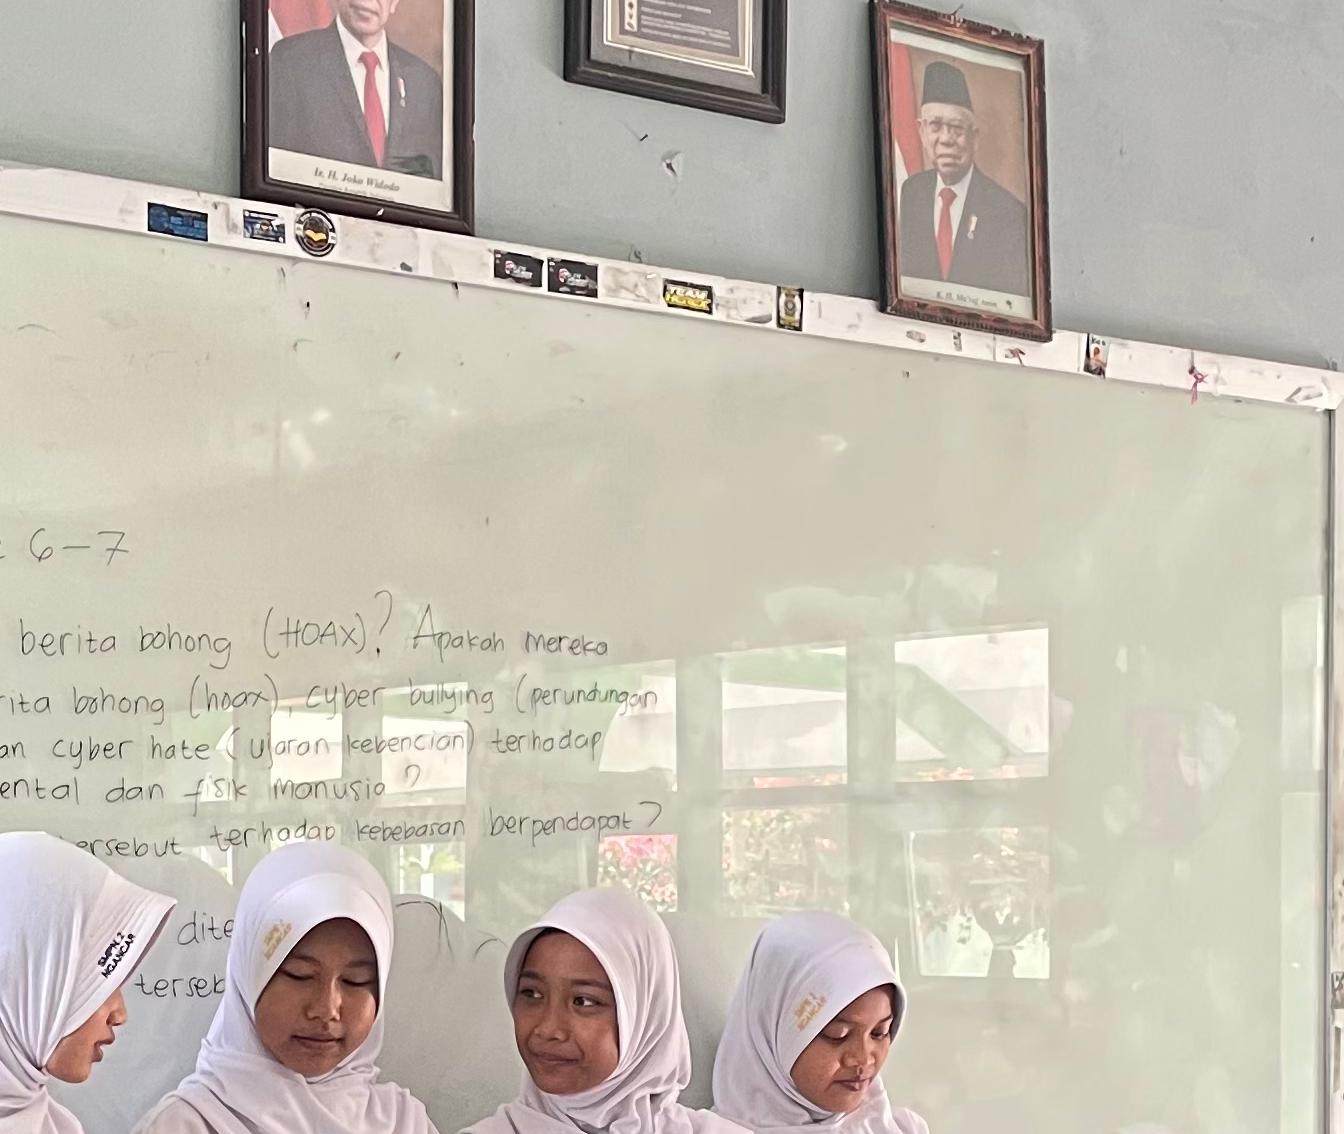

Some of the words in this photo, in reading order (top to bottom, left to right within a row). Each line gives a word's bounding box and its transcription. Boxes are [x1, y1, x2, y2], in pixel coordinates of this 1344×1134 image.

[20, 618, 117, 657] berita
[139, 624, 232, 669] bohong
[412, 603, 505, 663] Apakah
[524, 632, 609, 656] mereka
[73, 685, 165, 725] bohong
[306, 682, 386, 723] cyber
[408, 682, 494, 714] bullying
[53, 731, 133, 769] cyber
[150, 734, 210, 761] hate
[346, 720, 474, 756] kebencian)
[491, 729, 602, 765] terhadap
[105, 777, 165, 802] dan
[184, 773, 247, 816] fisik
[272, 780, 386, 801] manusia
[59, 836, 183, 858] ersebut
[356, 818, 465, 843] kebebasan
